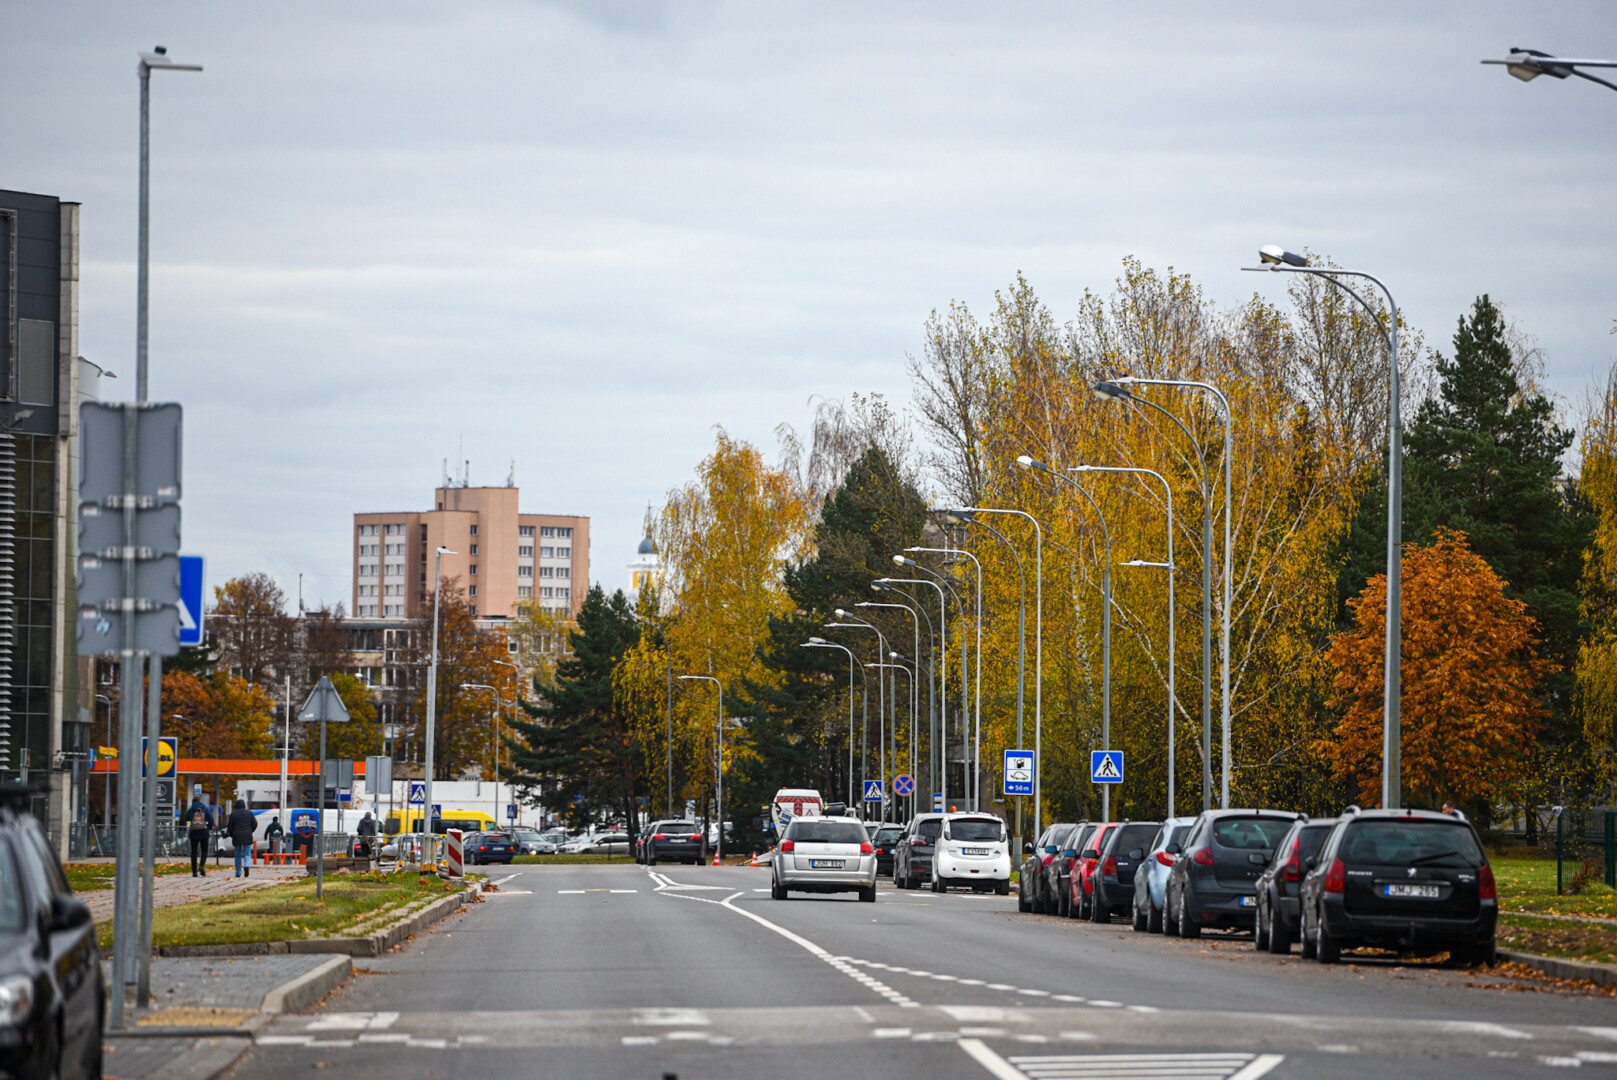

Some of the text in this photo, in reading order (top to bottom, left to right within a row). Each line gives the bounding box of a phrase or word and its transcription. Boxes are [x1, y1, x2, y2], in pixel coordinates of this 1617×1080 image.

[1391, 885, 1437, 896] JMJ 265
[1245, 896, 1256, 905] JN
